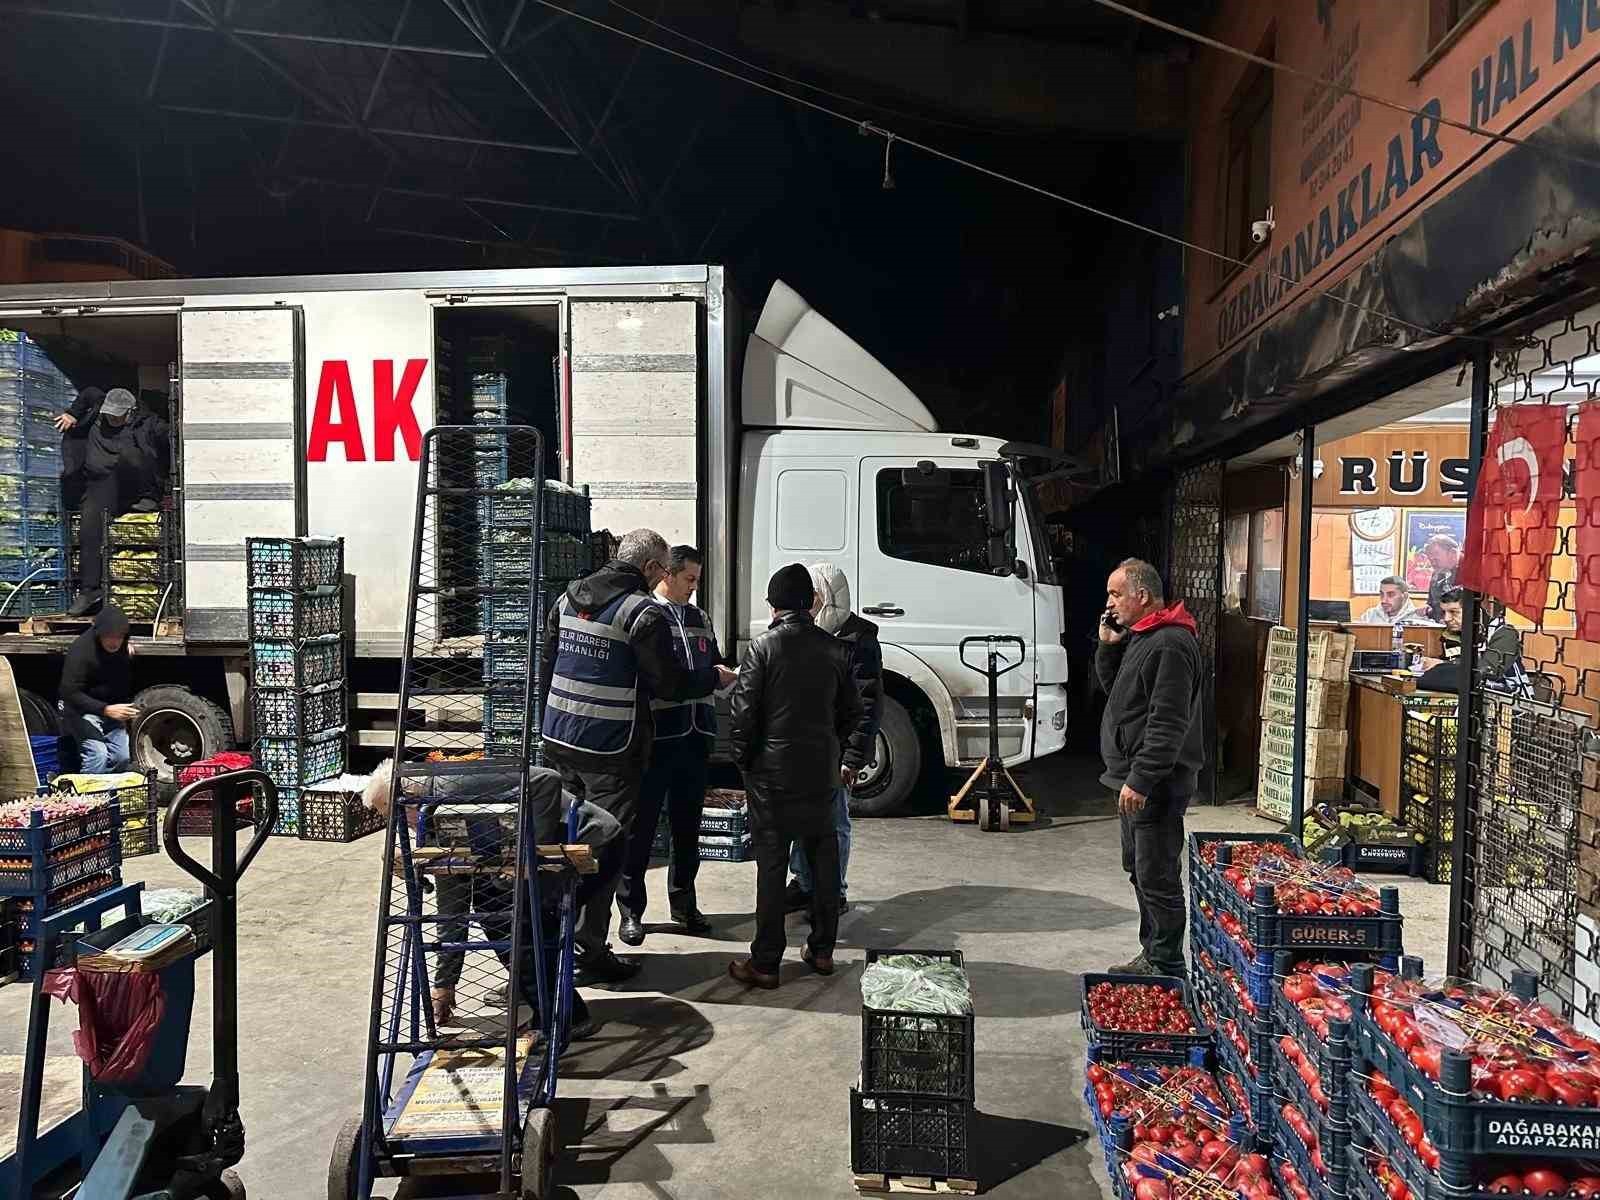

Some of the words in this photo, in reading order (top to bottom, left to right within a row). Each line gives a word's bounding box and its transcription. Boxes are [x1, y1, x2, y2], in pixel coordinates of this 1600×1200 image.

[1470, 17, 1540, 133] HAL
[306, 358, 429, 462] AK
[1338, 450, 1471, 503] RÜŞ
[722, 849, 729, 858] 3
[1496, 1134, 1600, 1150] ADAPAZARI
